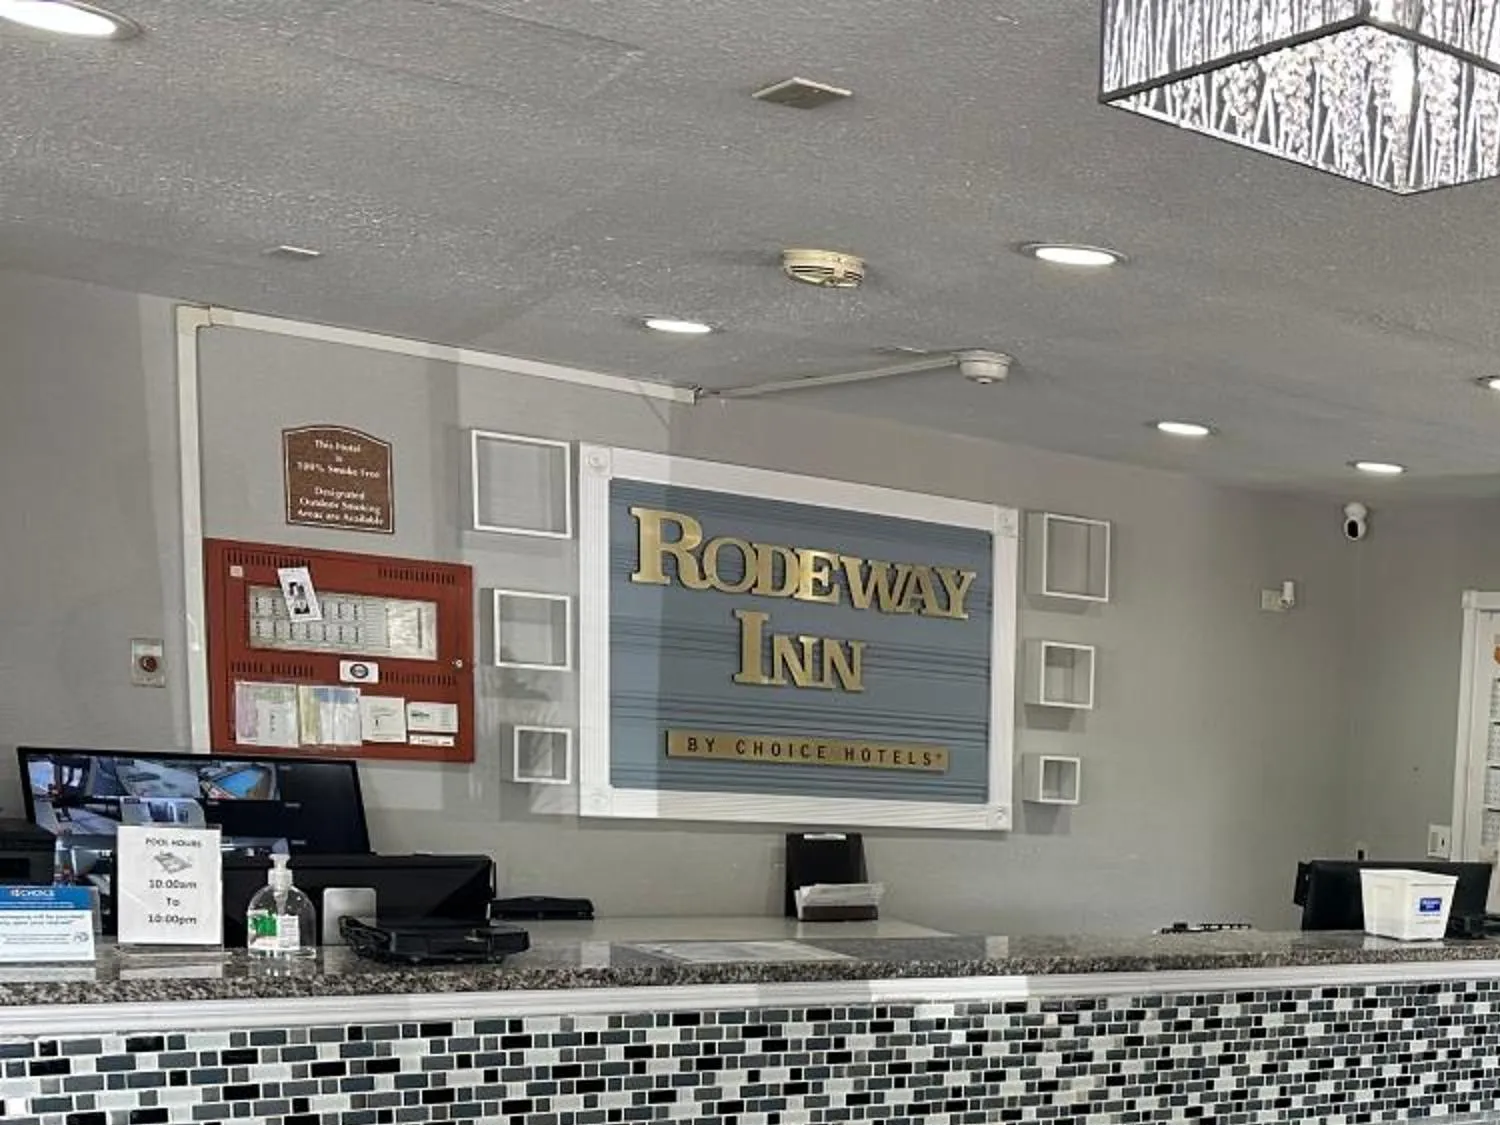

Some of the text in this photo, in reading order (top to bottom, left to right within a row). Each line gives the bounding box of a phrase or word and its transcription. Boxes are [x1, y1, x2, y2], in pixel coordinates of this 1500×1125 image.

[327, 464, 358, 477] Smoke
[314, 486, 365, 501] Designated
[630, 506, 977, 620] RODEWAY
[732, 608, 865, 692] INN
[687, 737, 932, 766] BY CHOICE HOTELS
[145, 837, 169, 848] POOL
[166, 897, 181, 907] To
